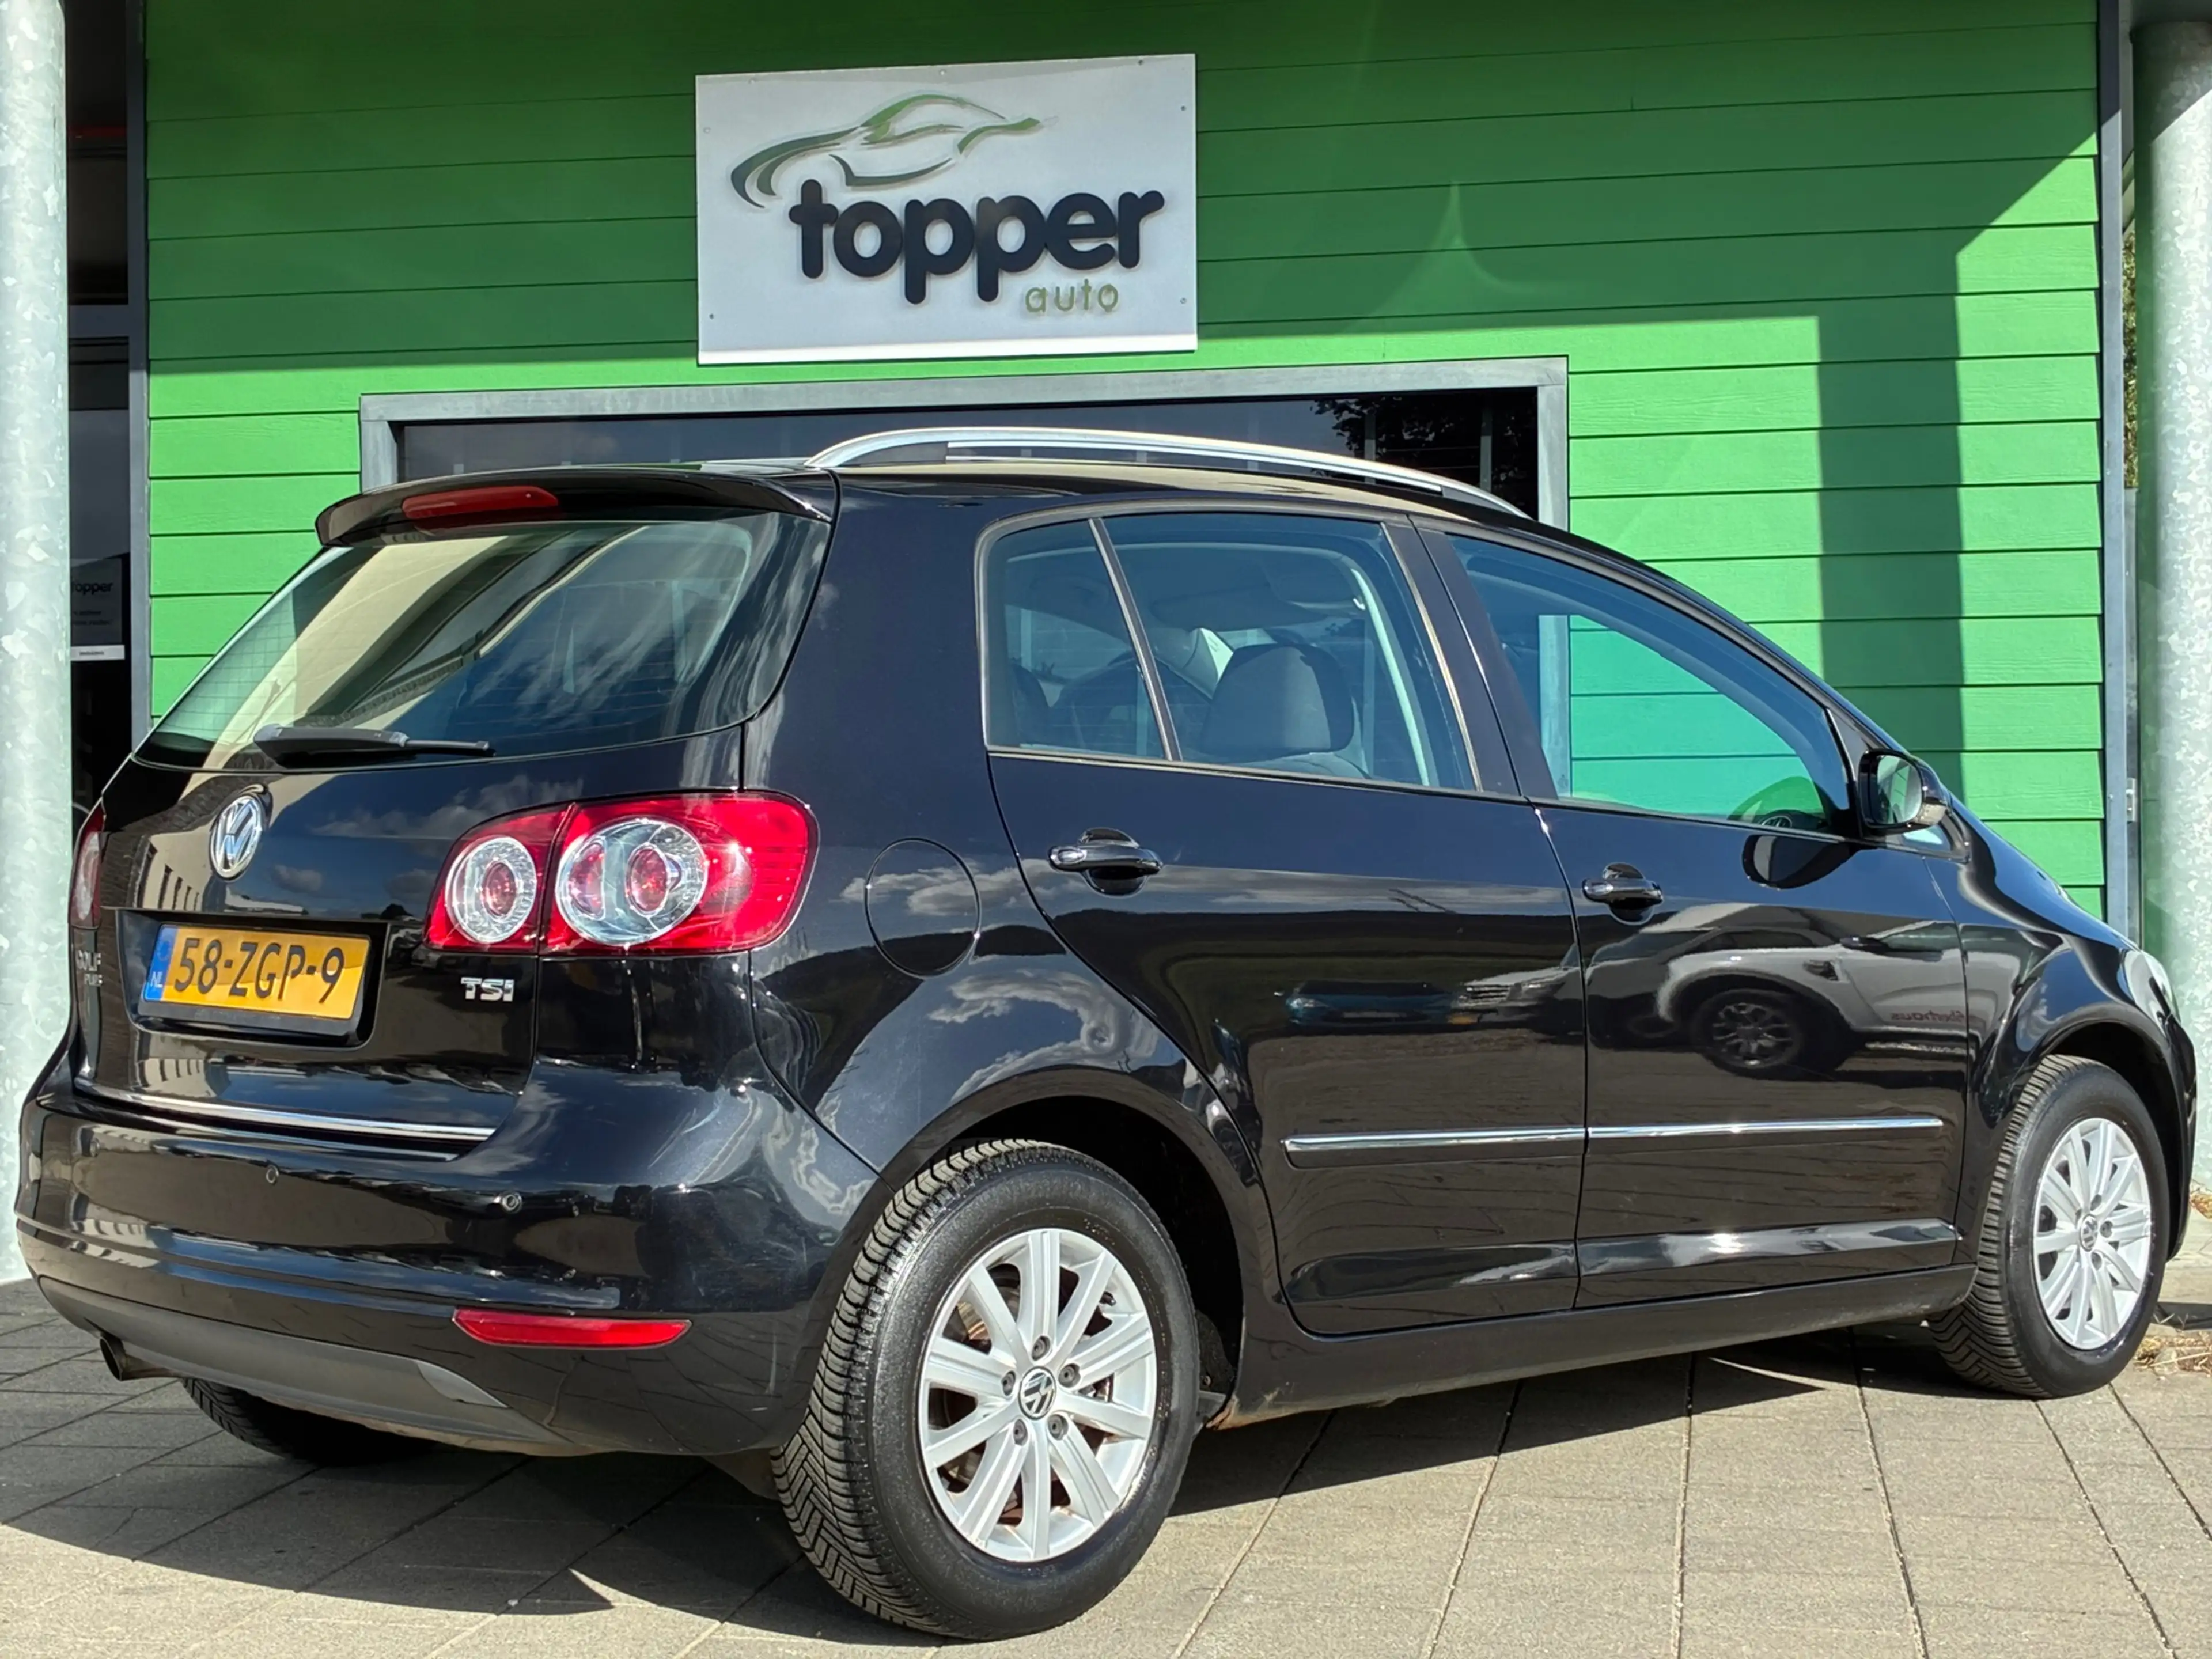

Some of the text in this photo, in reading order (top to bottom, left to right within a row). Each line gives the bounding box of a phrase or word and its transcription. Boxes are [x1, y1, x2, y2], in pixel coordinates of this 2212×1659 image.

[789, 179, 1165, 304] topper
[1025, 279, 1119, 313] auto
[150, 971, 164, 988] NL
[174, 937, 344, 1003] 58-ZGP-9
[460, 977, 514, 1002] TSI
